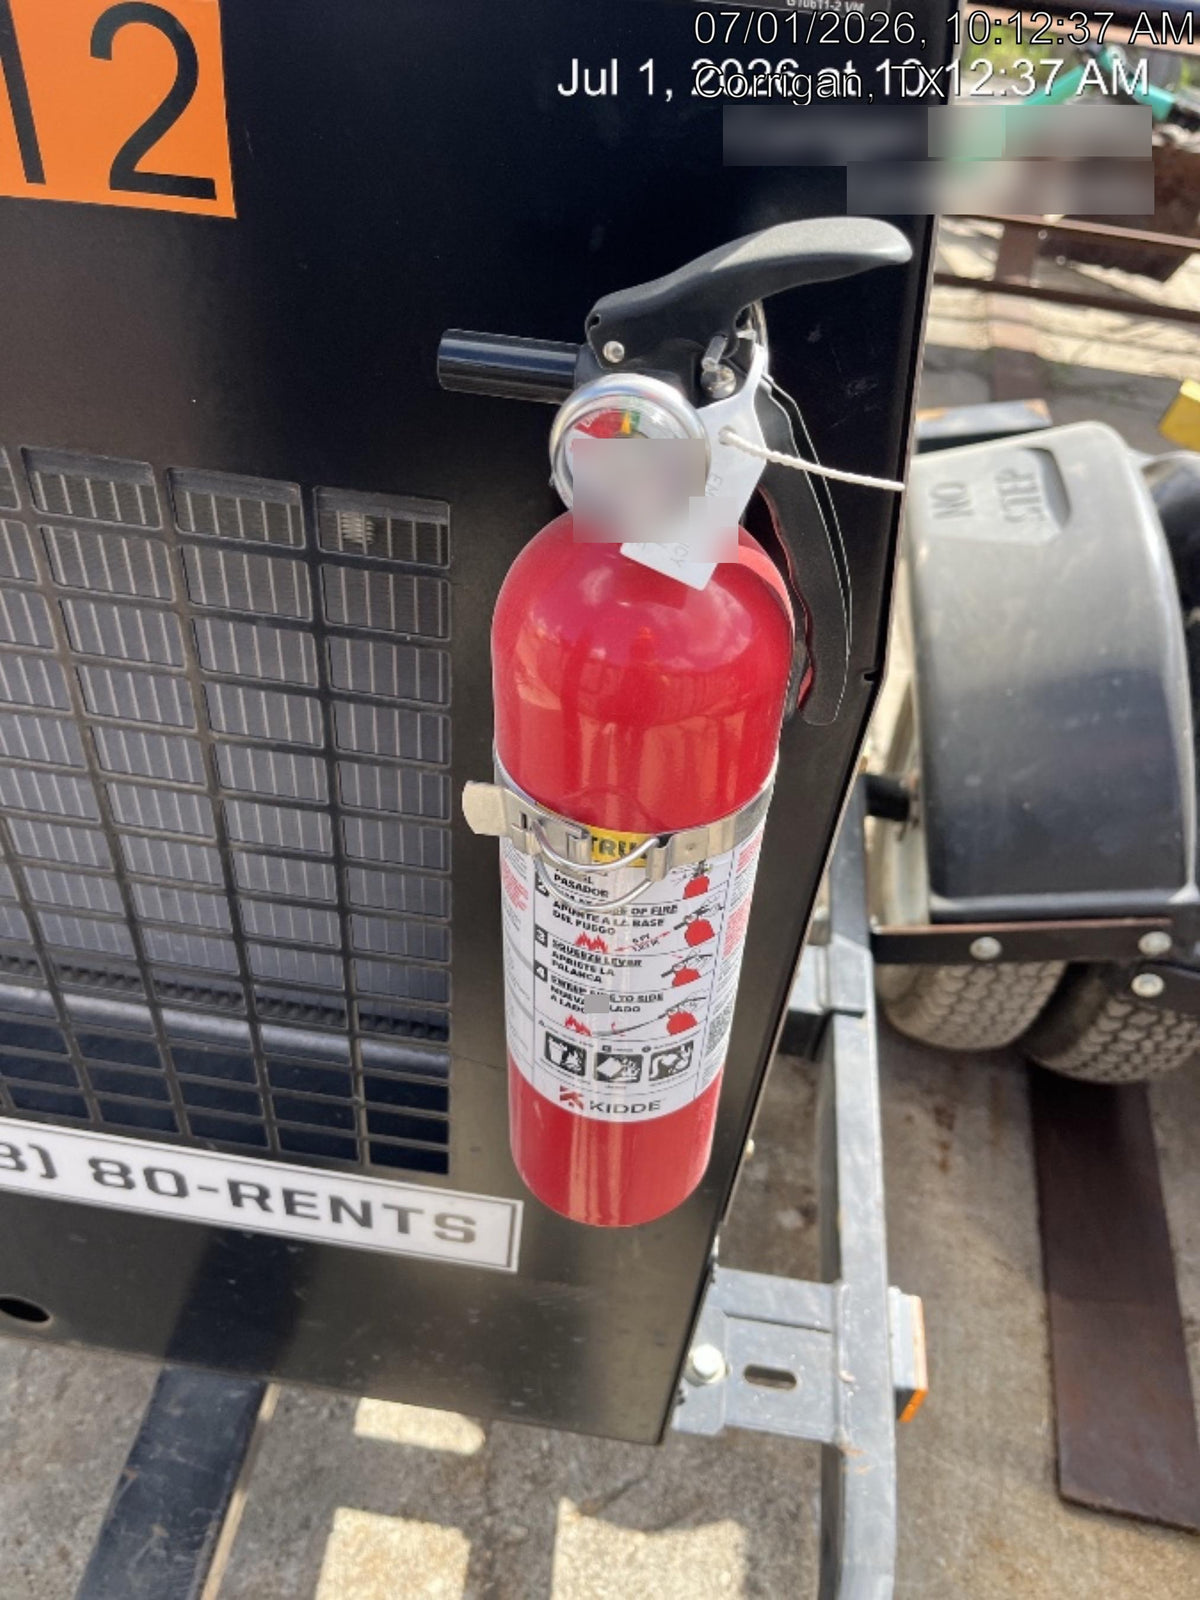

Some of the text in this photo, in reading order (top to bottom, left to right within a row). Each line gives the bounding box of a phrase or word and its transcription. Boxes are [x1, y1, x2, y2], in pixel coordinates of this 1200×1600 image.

[554, 873, 609, 898] PASADOR
[589, 1100, 662, 1114] KIDDE
[88, 1156, 477, 1244] 80-RENTS
